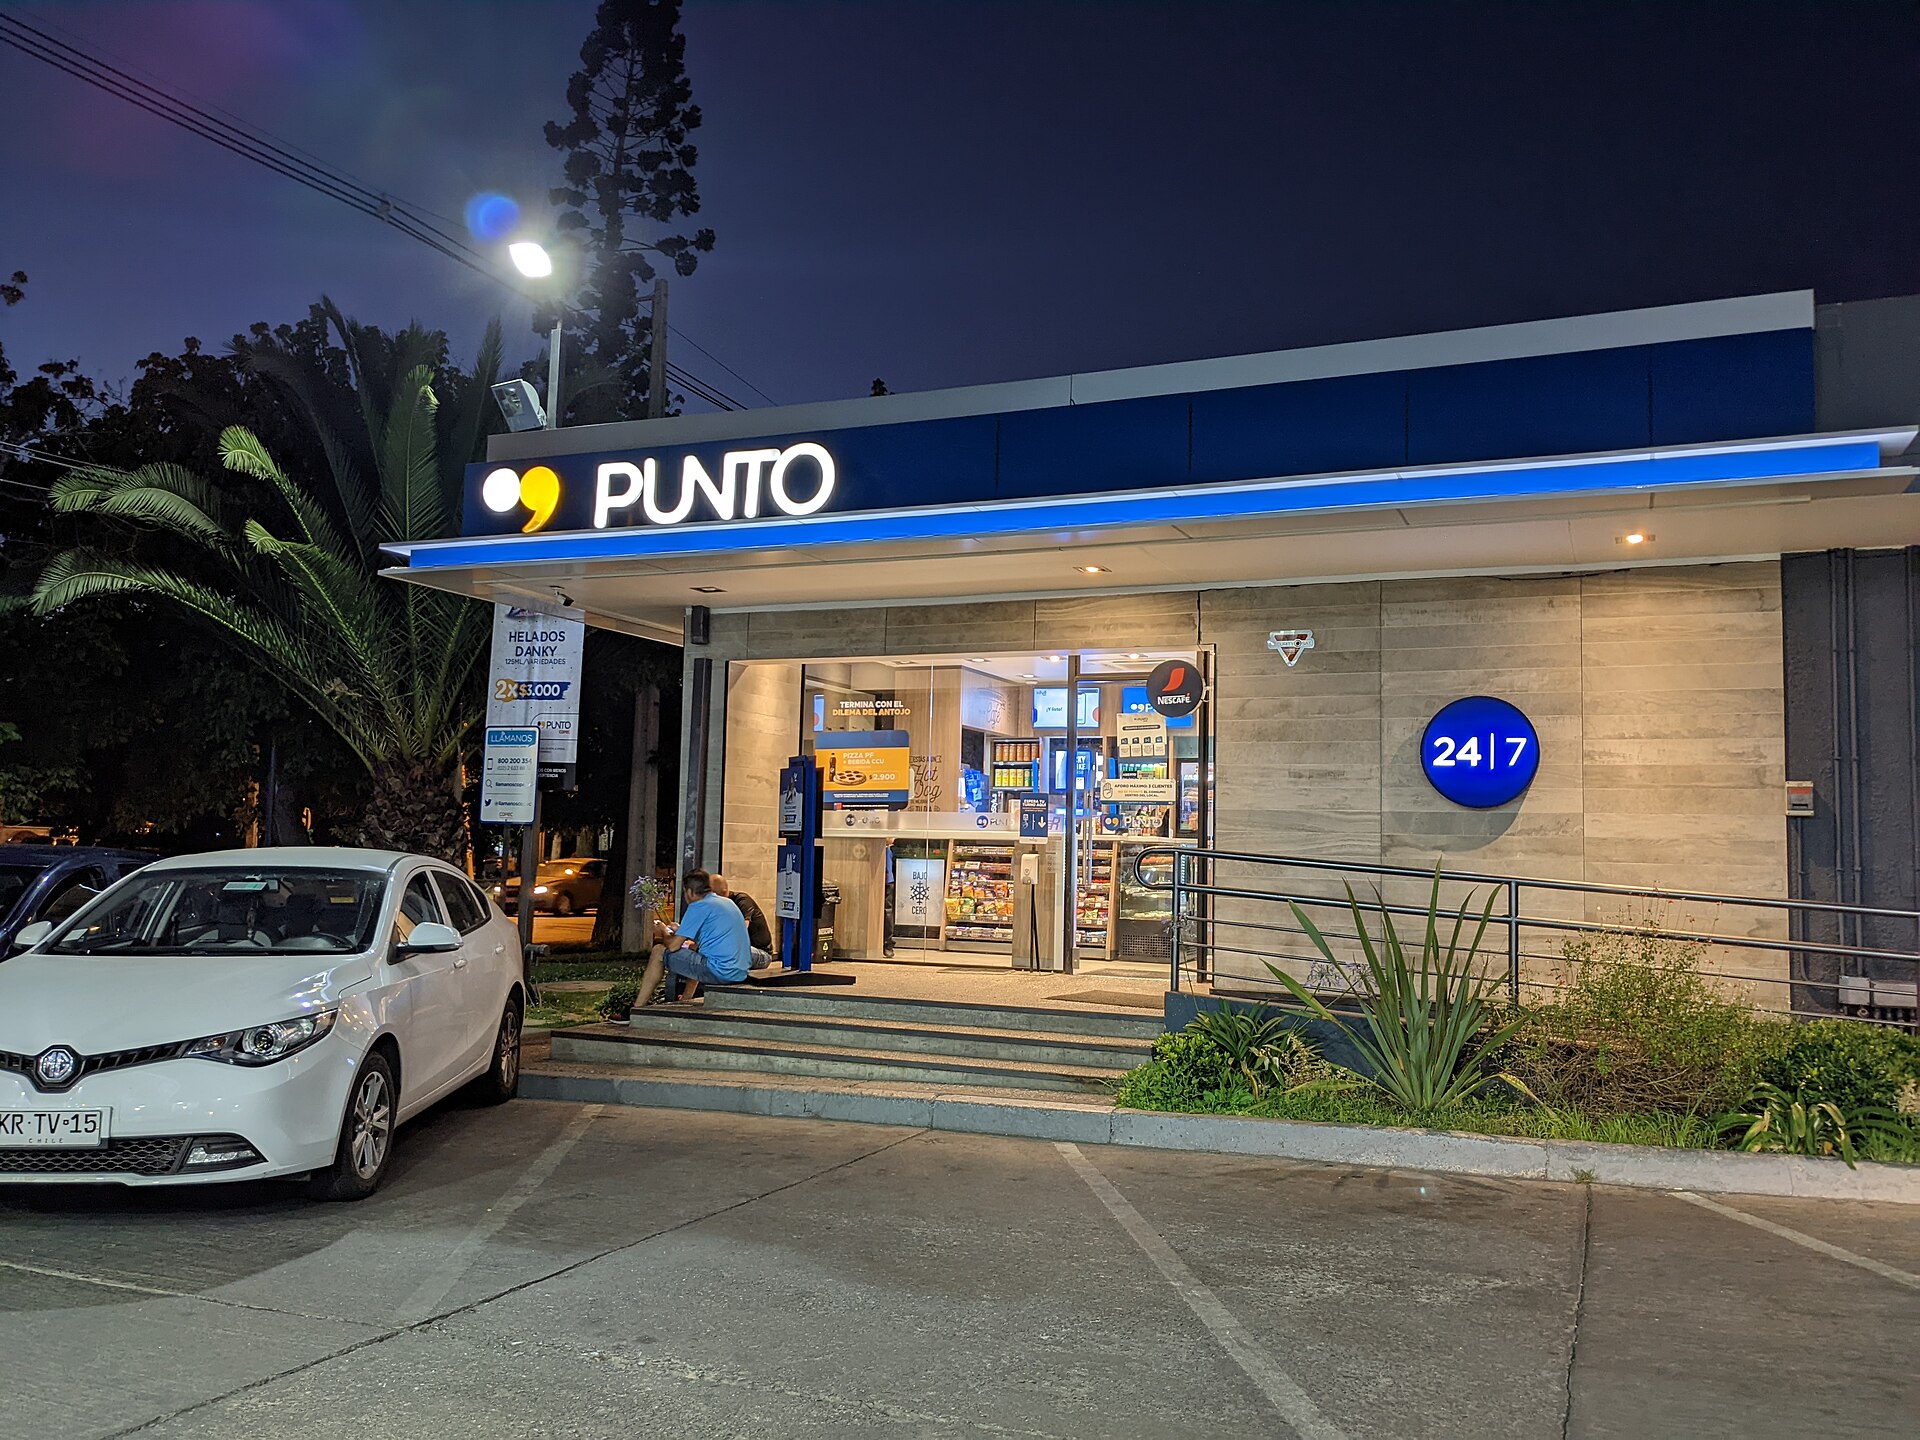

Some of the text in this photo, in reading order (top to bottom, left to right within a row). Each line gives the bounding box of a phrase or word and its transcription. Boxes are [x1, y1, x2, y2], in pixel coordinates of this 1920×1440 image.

[593, 442, 836, 530] PUNTO
[508, 631, 566, 643] HELADOS
[515, 646, 558, 657] DANKY
[519, 684, 561, 697] $3.000
[1157, 691, 1192, 705] NESCAFÉ
[839, 700, 904, 709] TERMINA CON EL
[862, 708, 878, 716] DEL
[878, 708, 911, 716] ANTOJO
[546, 720, 572, 730] PUNTO
[909, 763, 939, 782] Hot
[914, 779, 942, 803] Dog
[1124, 814, 1163, 829] PUNTO
[912, 871, 928, 880] BAJO
[911, 905, 928, 915] CERO
